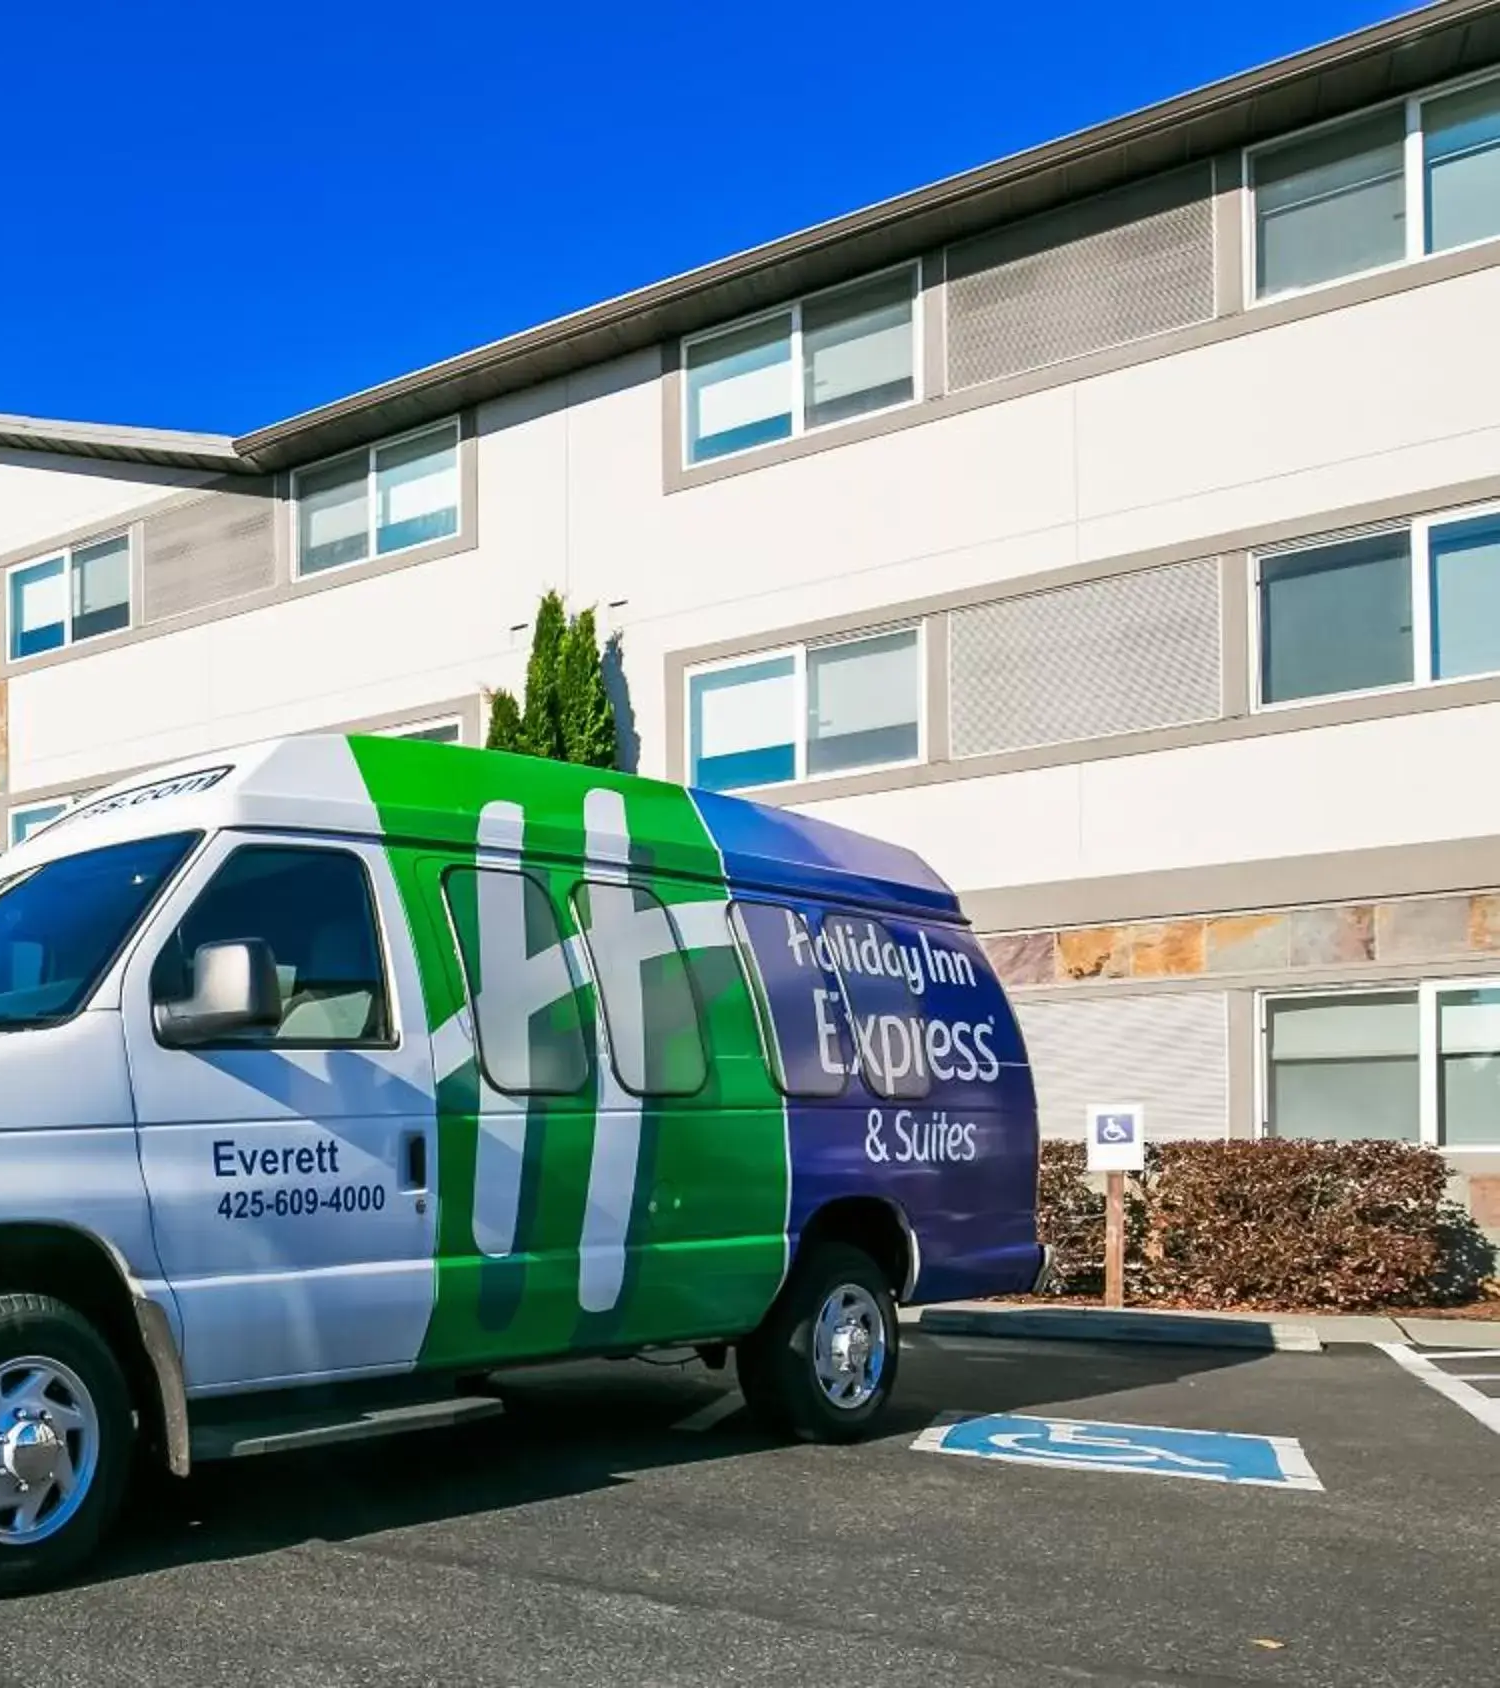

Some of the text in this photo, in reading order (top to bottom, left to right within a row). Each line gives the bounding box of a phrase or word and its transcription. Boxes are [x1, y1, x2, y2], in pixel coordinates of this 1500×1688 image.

[786, 909, 977, 995] Holiday Inn
[813, 988, 999, 1096] Express
[212, 1140, 340, 1177] Everett
[865, 1107, 978, 1163] & Suites
[217, 1184, 386, 1220] 425-609-4000
